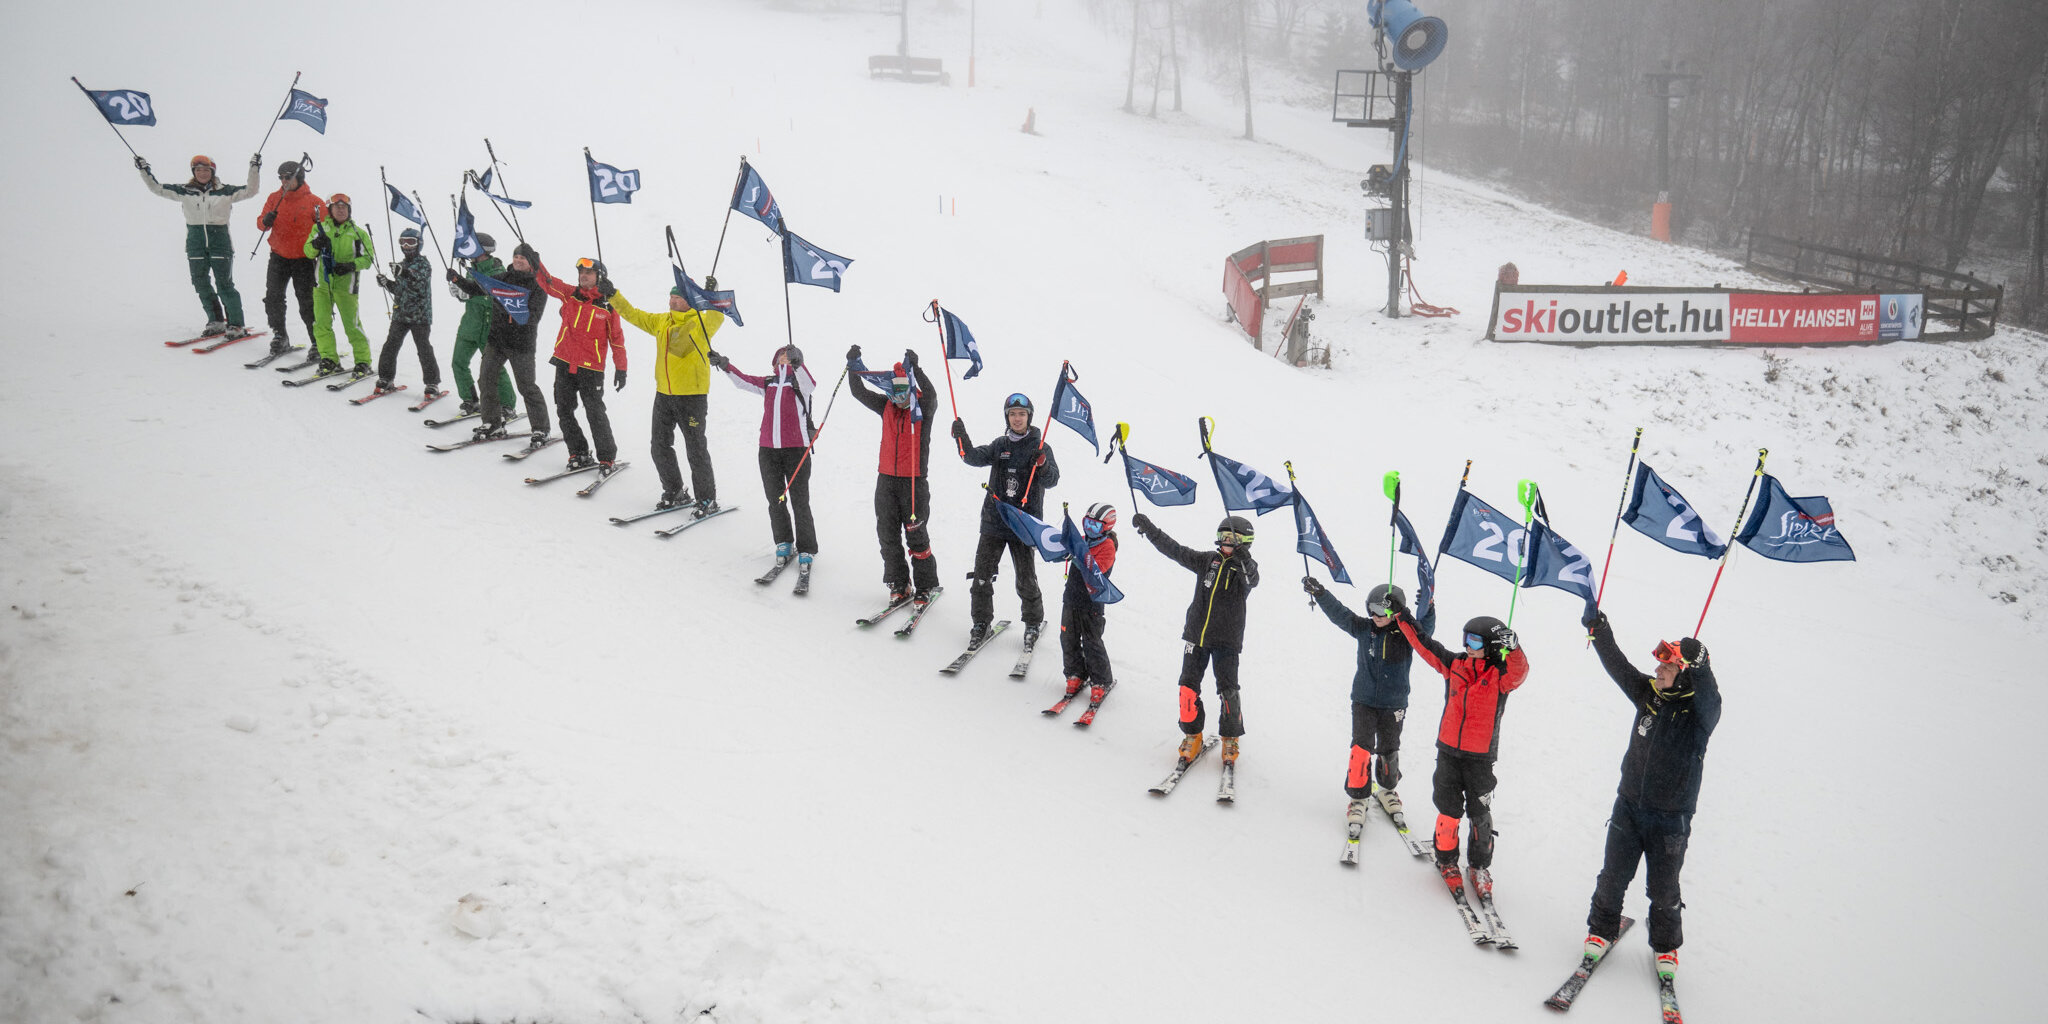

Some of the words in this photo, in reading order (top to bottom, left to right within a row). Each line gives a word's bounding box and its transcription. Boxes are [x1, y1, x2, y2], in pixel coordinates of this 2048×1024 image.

[109, 92, 150, 121] 20
[594, 168, 637, 197] 20
[1502, 300, 1724, 334] skioutlet.hu
[1732, 308, 1791, 328] HELLY
[1793, 308, 1856, 328] HANSEN
[1472, 521, 1530, 568] 20
